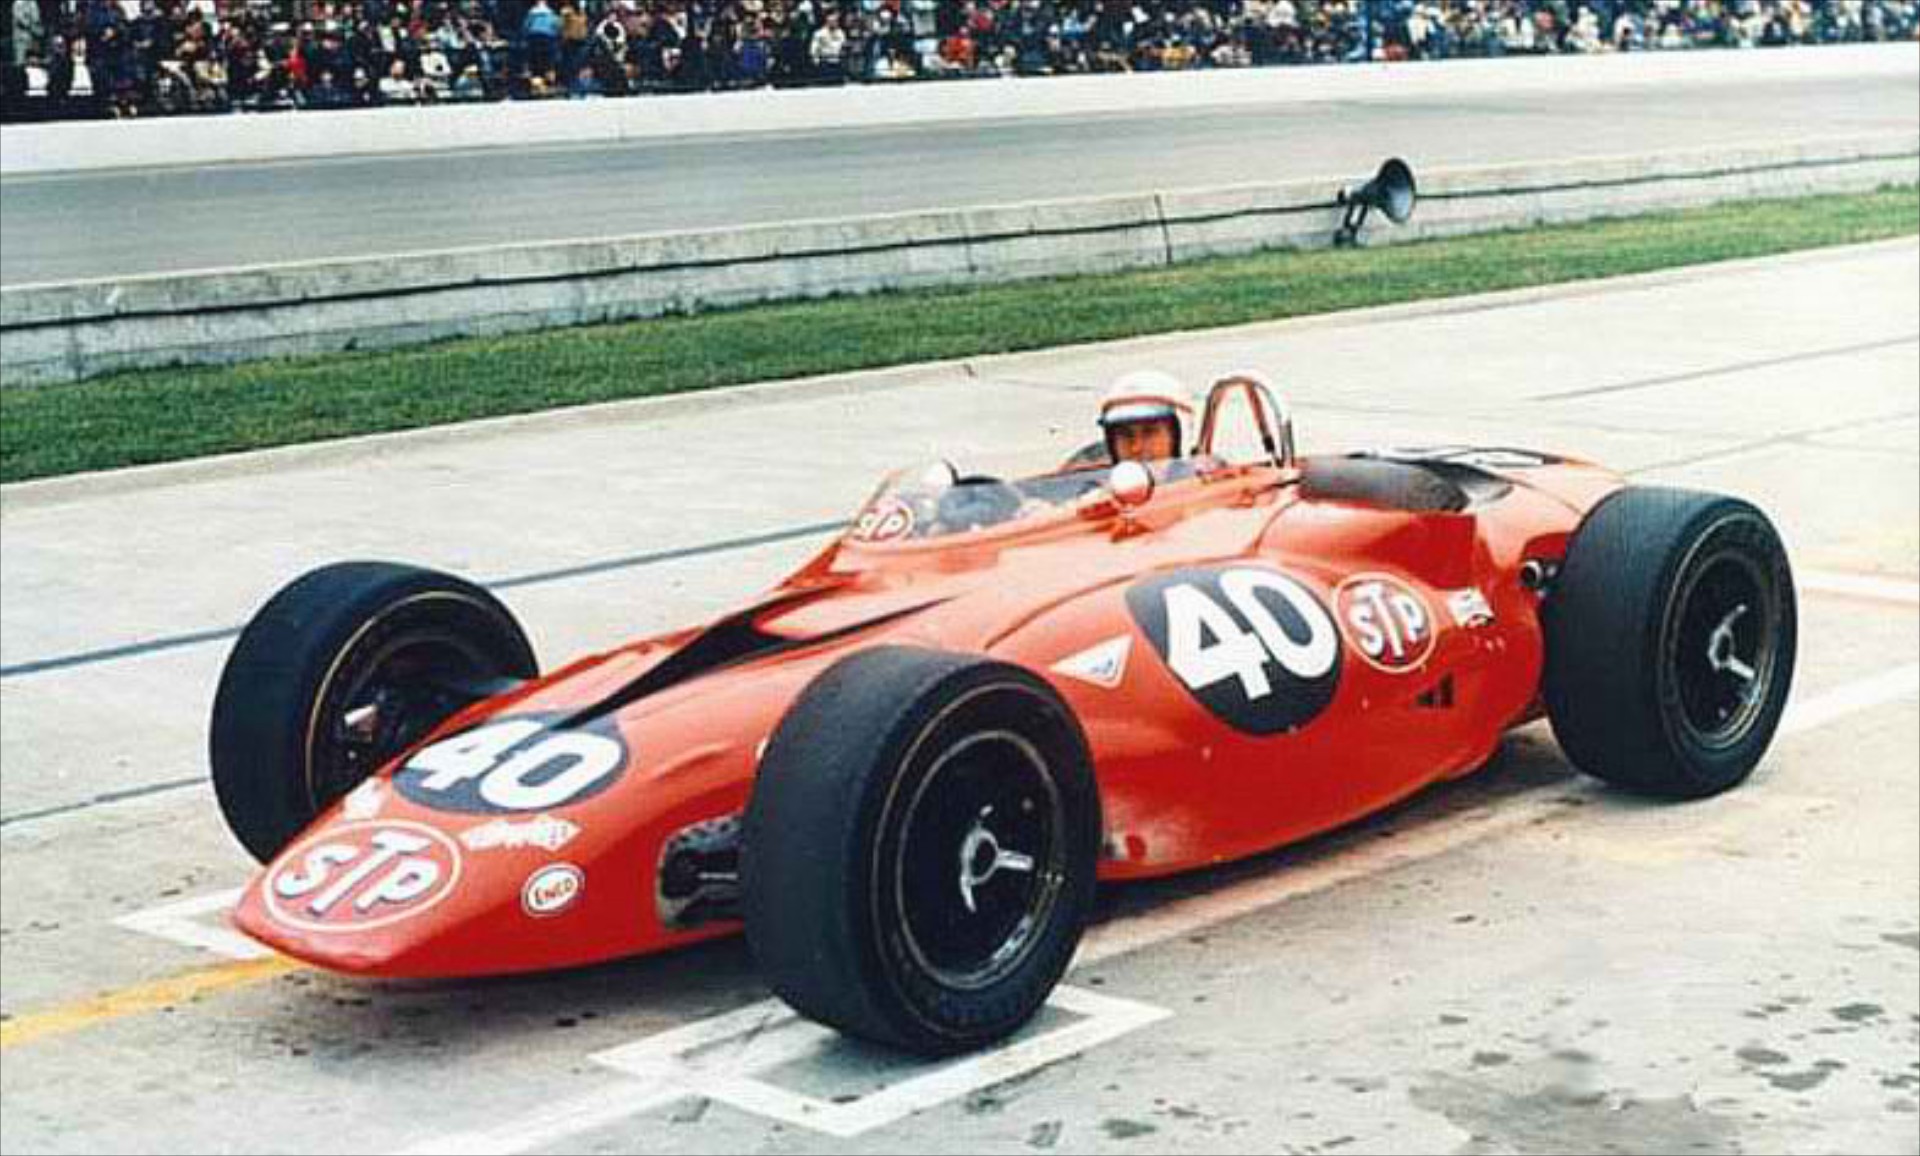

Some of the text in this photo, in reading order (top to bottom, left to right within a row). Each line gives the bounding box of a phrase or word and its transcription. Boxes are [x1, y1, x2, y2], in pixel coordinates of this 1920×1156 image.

[1162, 568, 1339, 700] 40
[1349, 581, 1427, 657] STP
[403, 718, 622, 810] 40
[273, 830, 440, 917] STP
